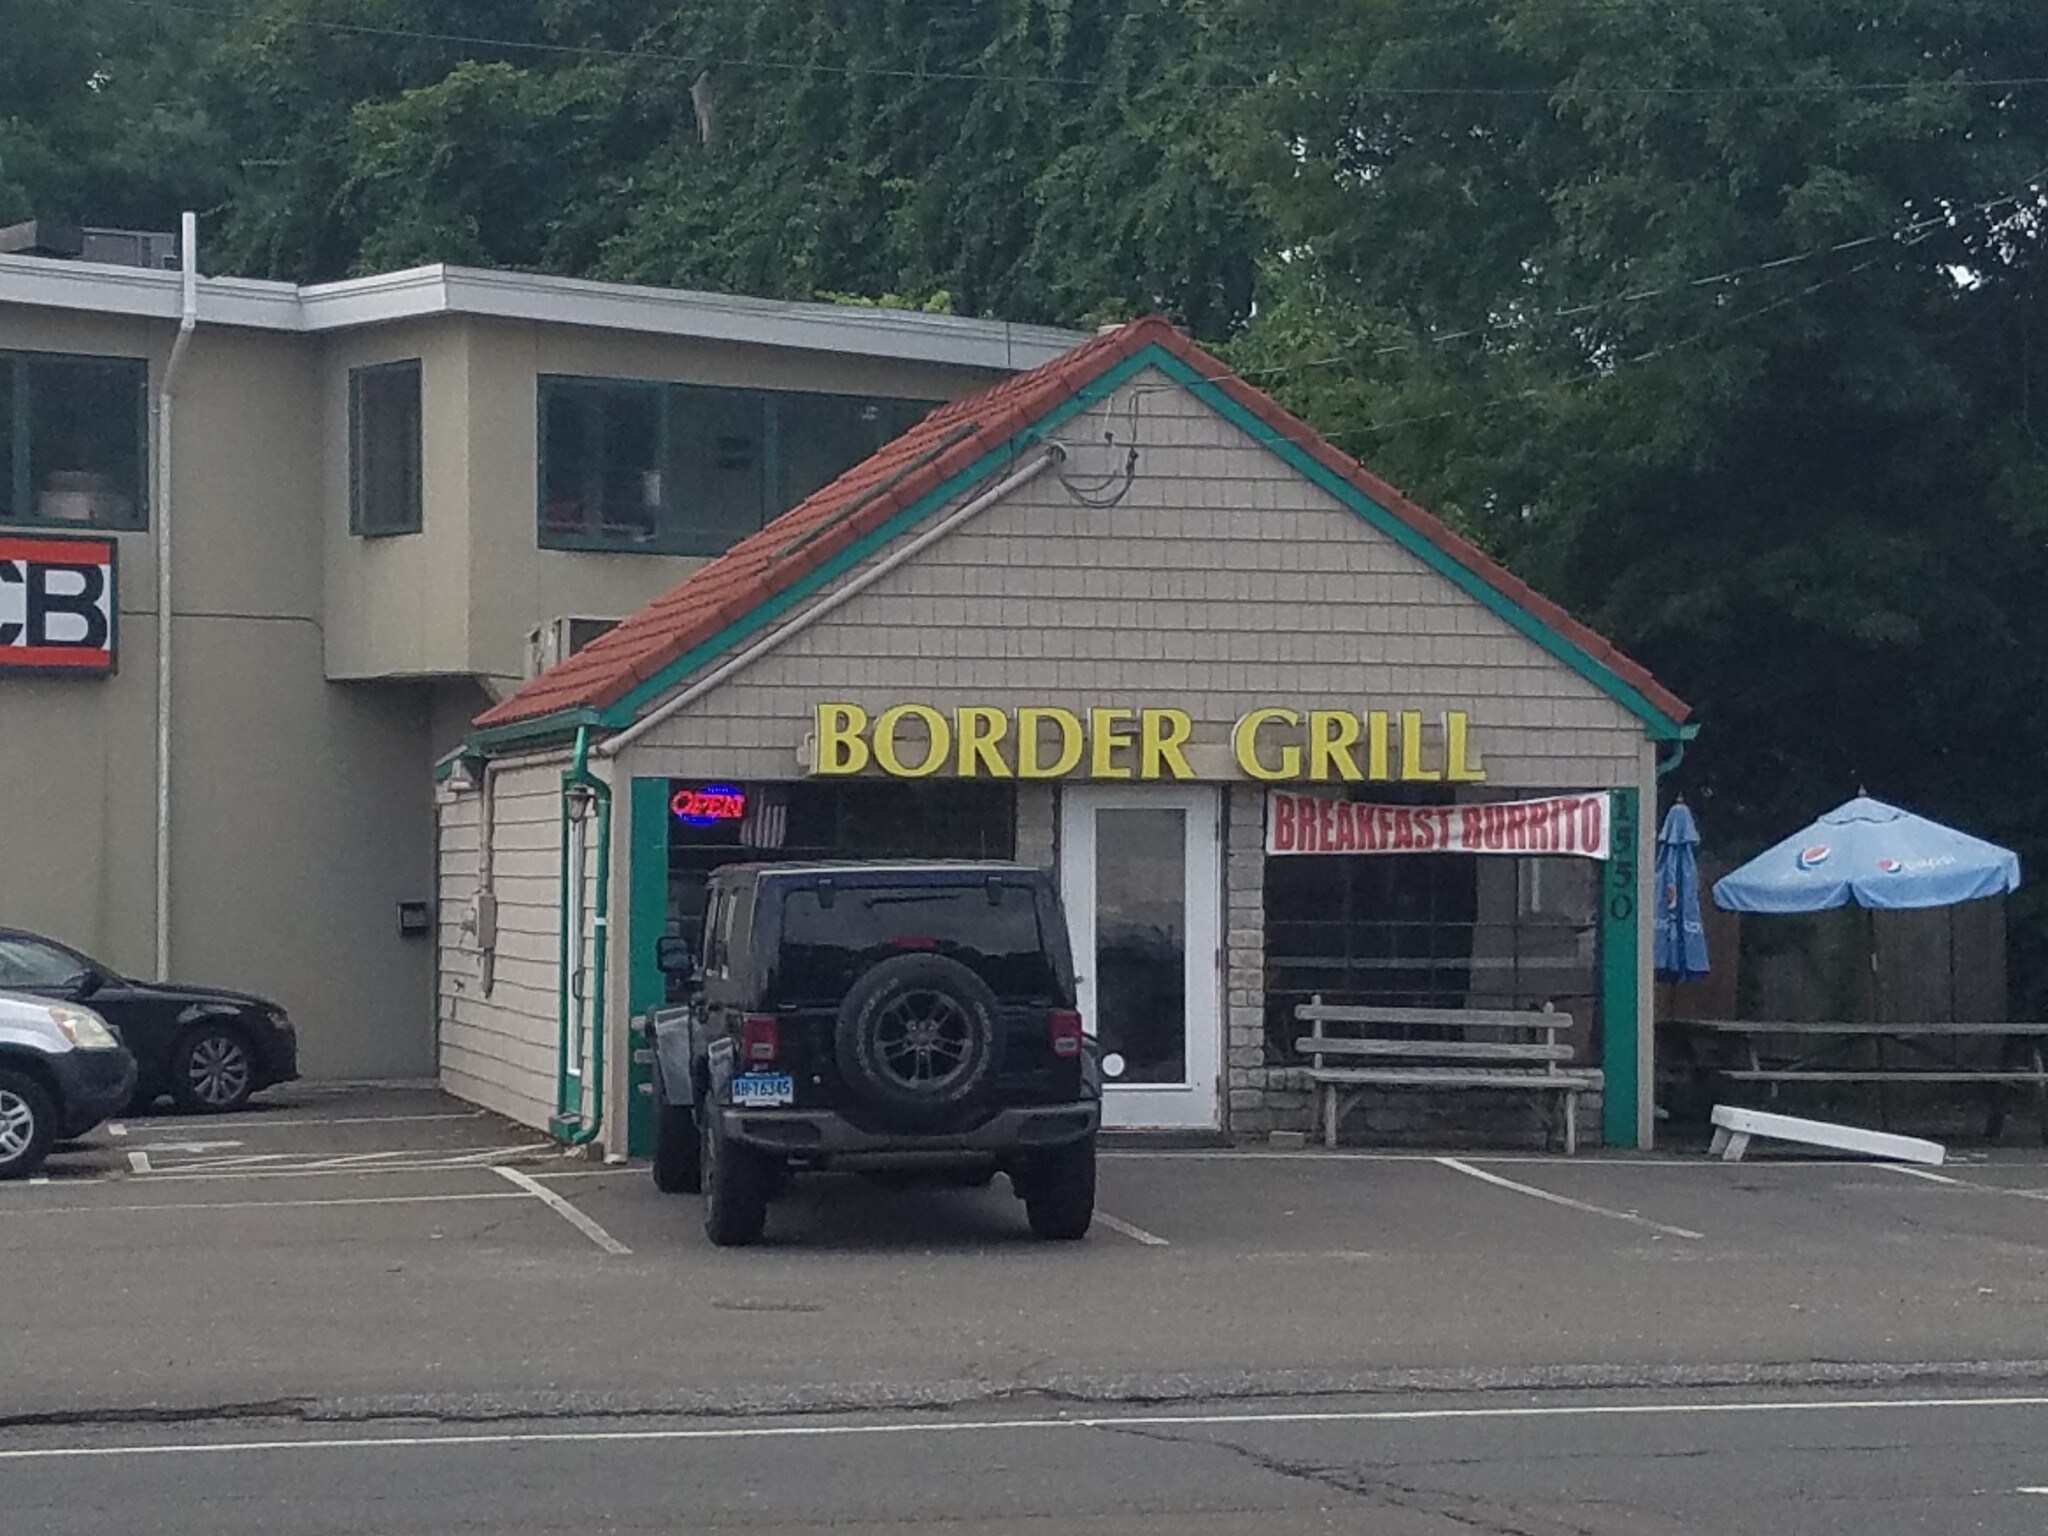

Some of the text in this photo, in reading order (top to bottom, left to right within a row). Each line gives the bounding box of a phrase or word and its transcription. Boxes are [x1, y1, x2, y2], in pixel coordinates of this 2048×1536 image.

[816, 703, 1486, 782] BORDER GRILL
[671, 790, 745, 818] OPEN
[1274, 794, 1600, 853] BREAKFAST BURRITO
[1611, 794, 1633, 921] 1550
